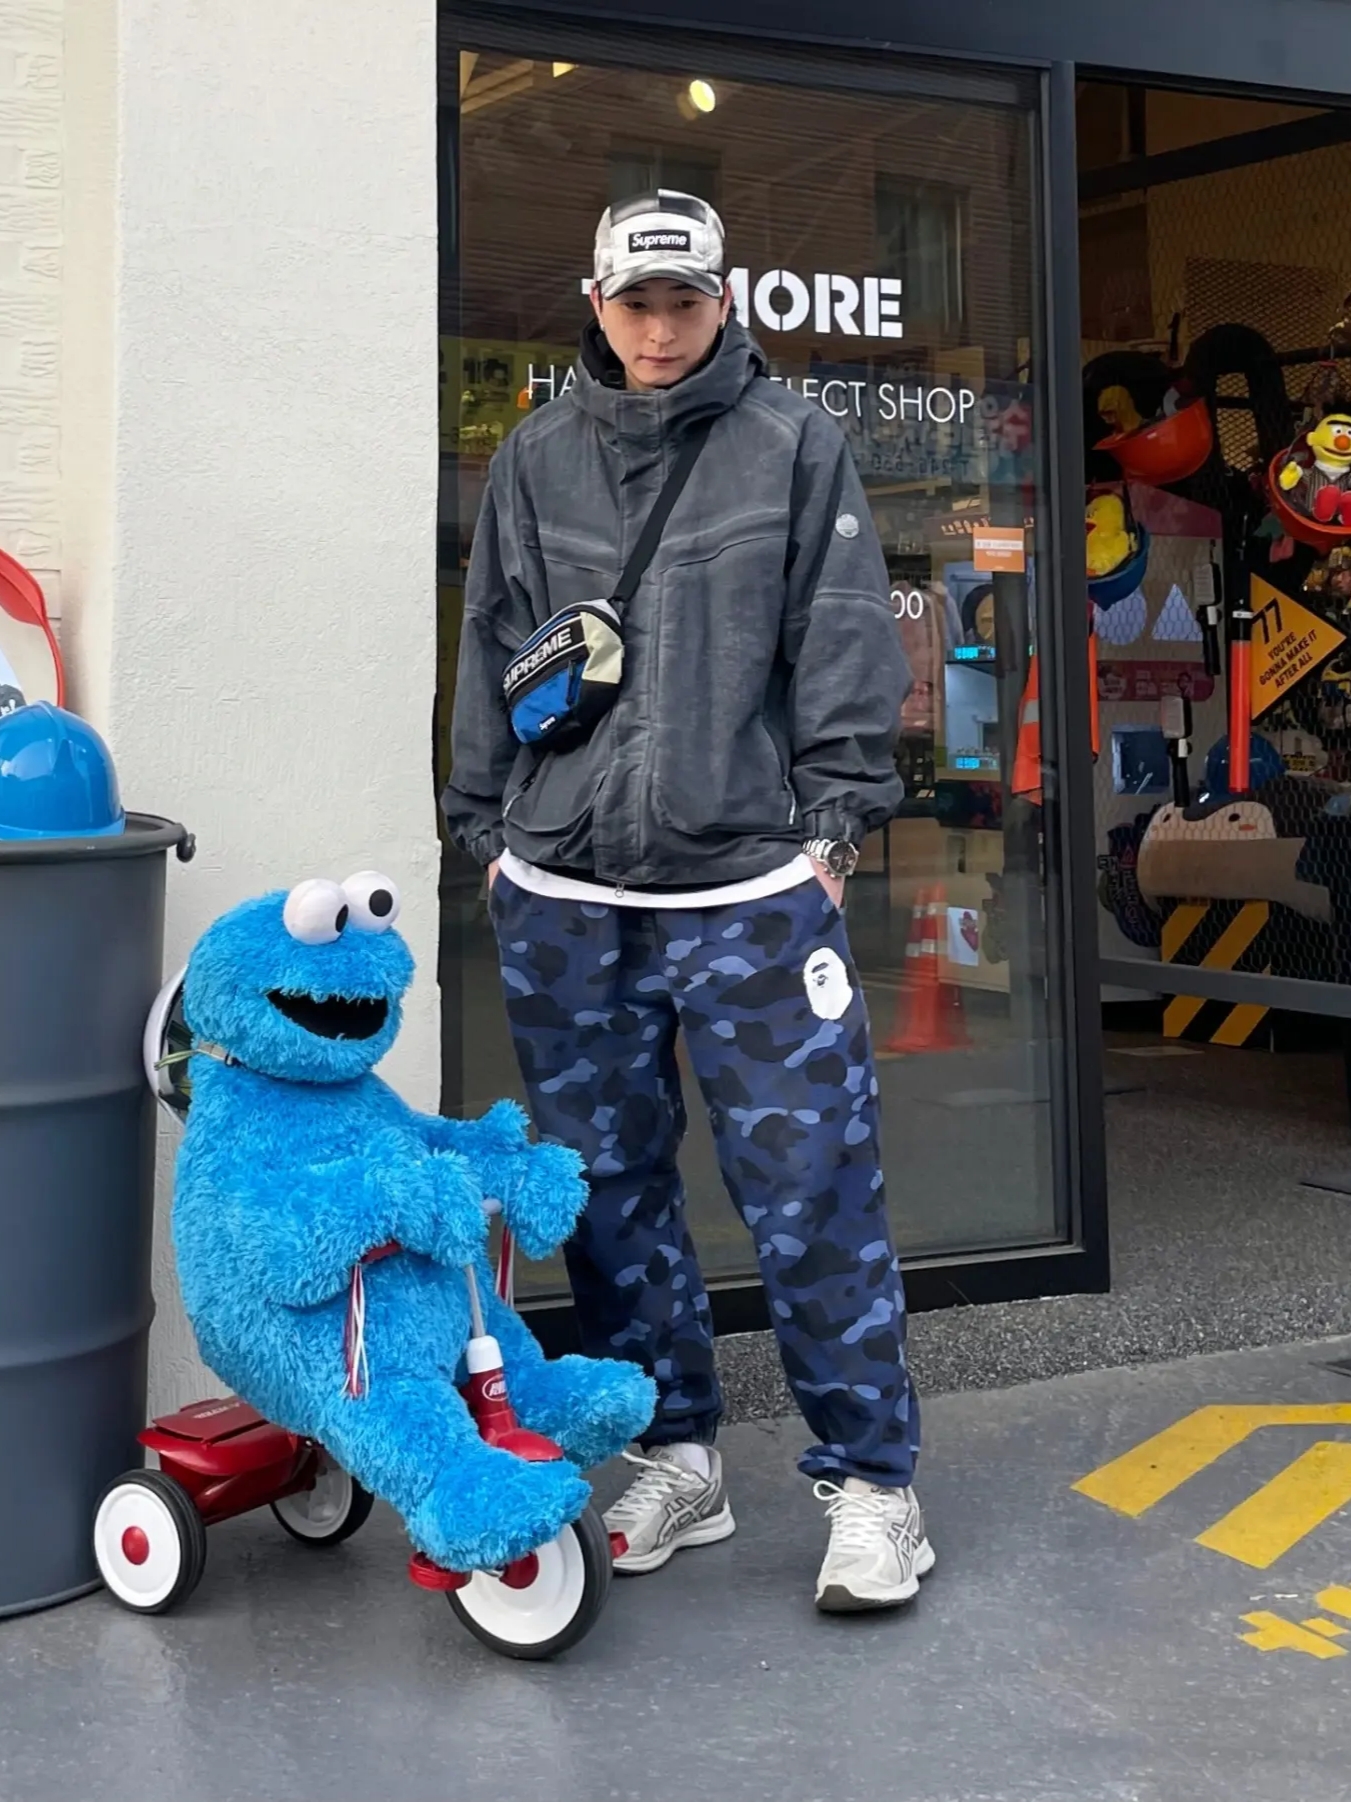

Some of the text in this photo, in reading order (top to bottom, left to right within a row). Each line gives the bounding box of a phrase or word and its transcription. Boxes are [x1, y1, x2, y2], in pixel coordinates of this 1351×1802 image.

[631, 233, 688, 250] Supreme
[769, 376, 867, 418] ECT
[878, 383, 975, 424] SHOP
[1259, 656, 1287, 686] GONNA
[1285, 636, 1311, 662] MAKE
[1268, 631, 1297, 661] YOU'RE
[1274, 652, 1313, 688] AFTER ALL
